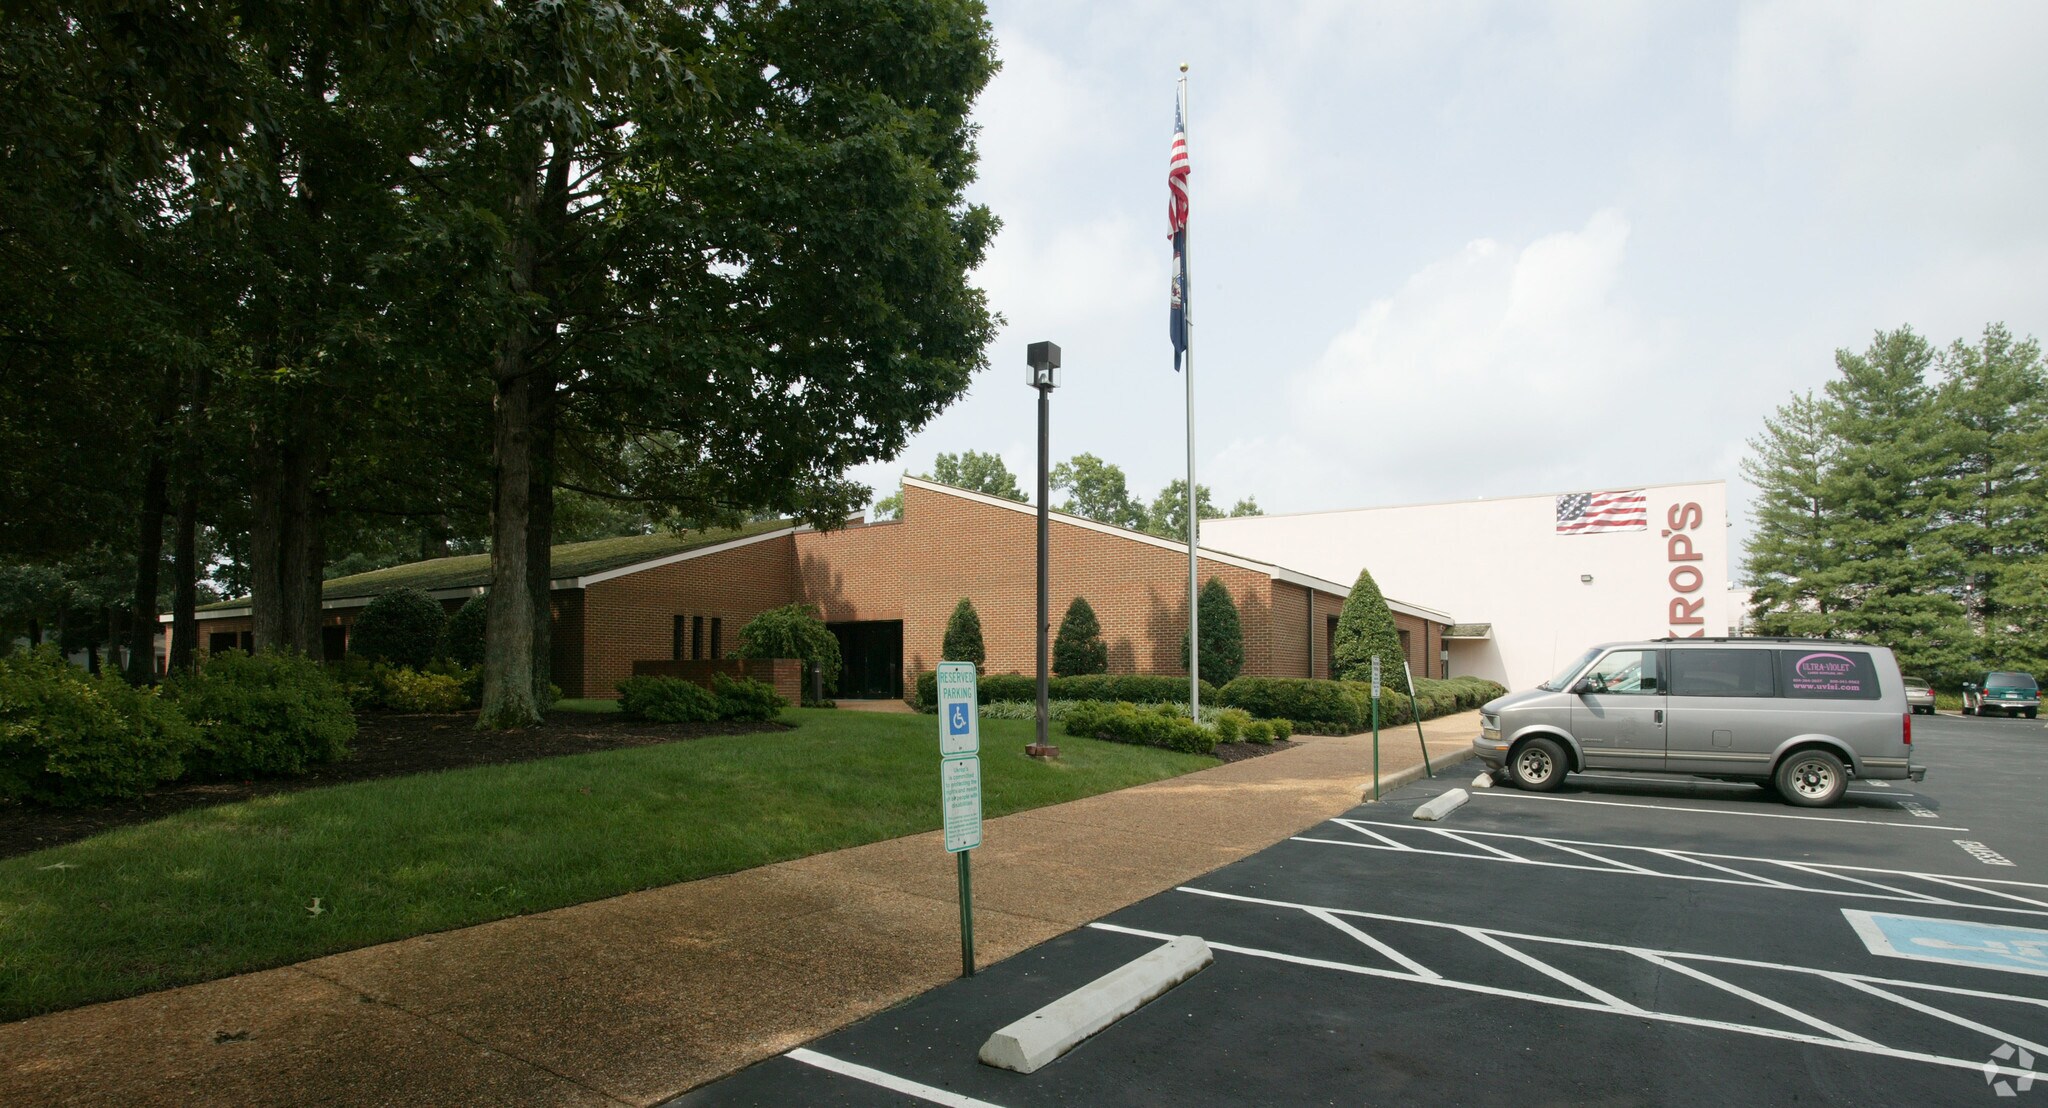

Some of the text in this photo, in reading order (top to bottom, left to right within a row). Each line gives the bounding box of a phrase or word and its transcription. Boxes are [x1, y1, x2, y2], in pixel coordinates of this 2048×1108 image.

[1802, 662, 1850, 671] ULTRA-VIOLET
[939, 672, 973, 683] RESERVED
[943, 687, 972, 699] PARKING
